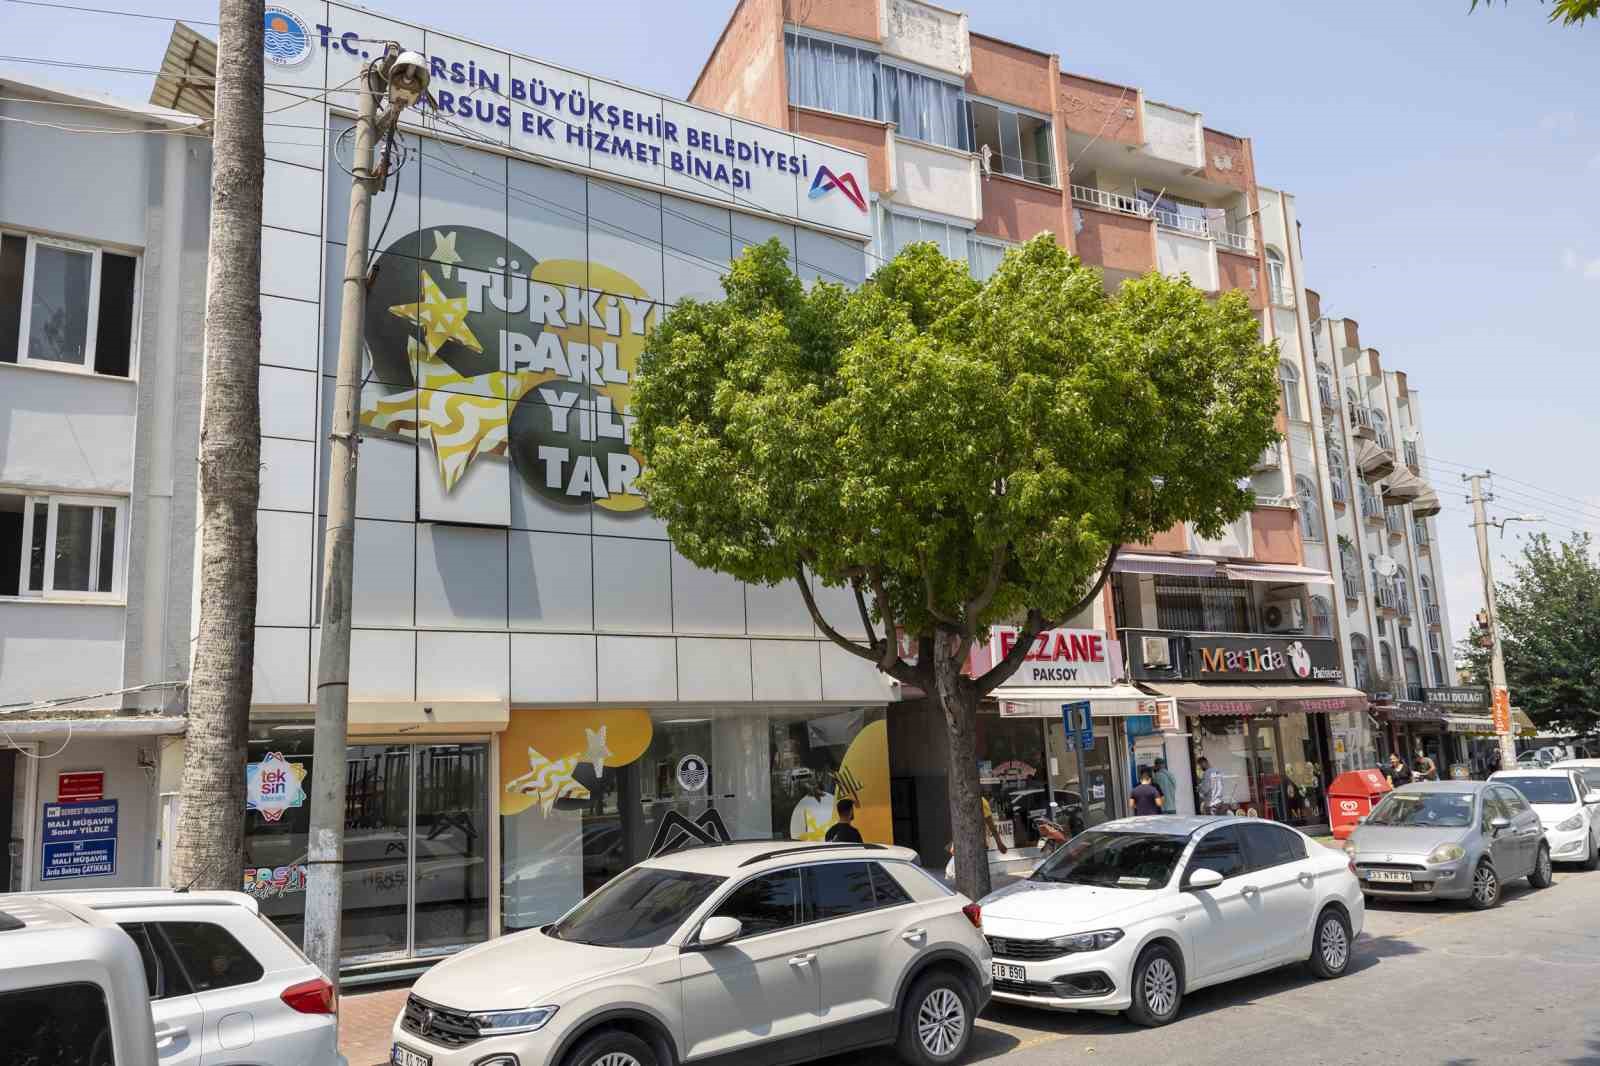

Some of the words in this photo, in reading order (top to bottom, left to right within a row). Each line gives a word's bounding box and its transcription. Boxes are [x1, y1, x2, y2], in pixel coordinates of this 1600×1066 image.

[316, 24, 368, 58] T.C.
[511, 78, 678, 142] BÜYÜKŞEHİR
[687, 128, 808, 177] BELEDİYESİ
[415, 88, 511, 127] RSUS
[522, 112, 554, 139] EK
[566, 122, 661, 165] HİZMET
[670, 150, 751, 189] BİNASI
[457, 256, 662, 337] TÜRKİY
[539, 388, 633, 446] YIL
[1001, 631, 1105, 663] EZANE
[1200, 646, 1286, 673] Matilda
[1033, 667, 1078, 682] PAKSOY
[261, 782, 286, 795] sin
[262, 768, 286, 783] tek
[1009, 966, 1023, 979] 690
